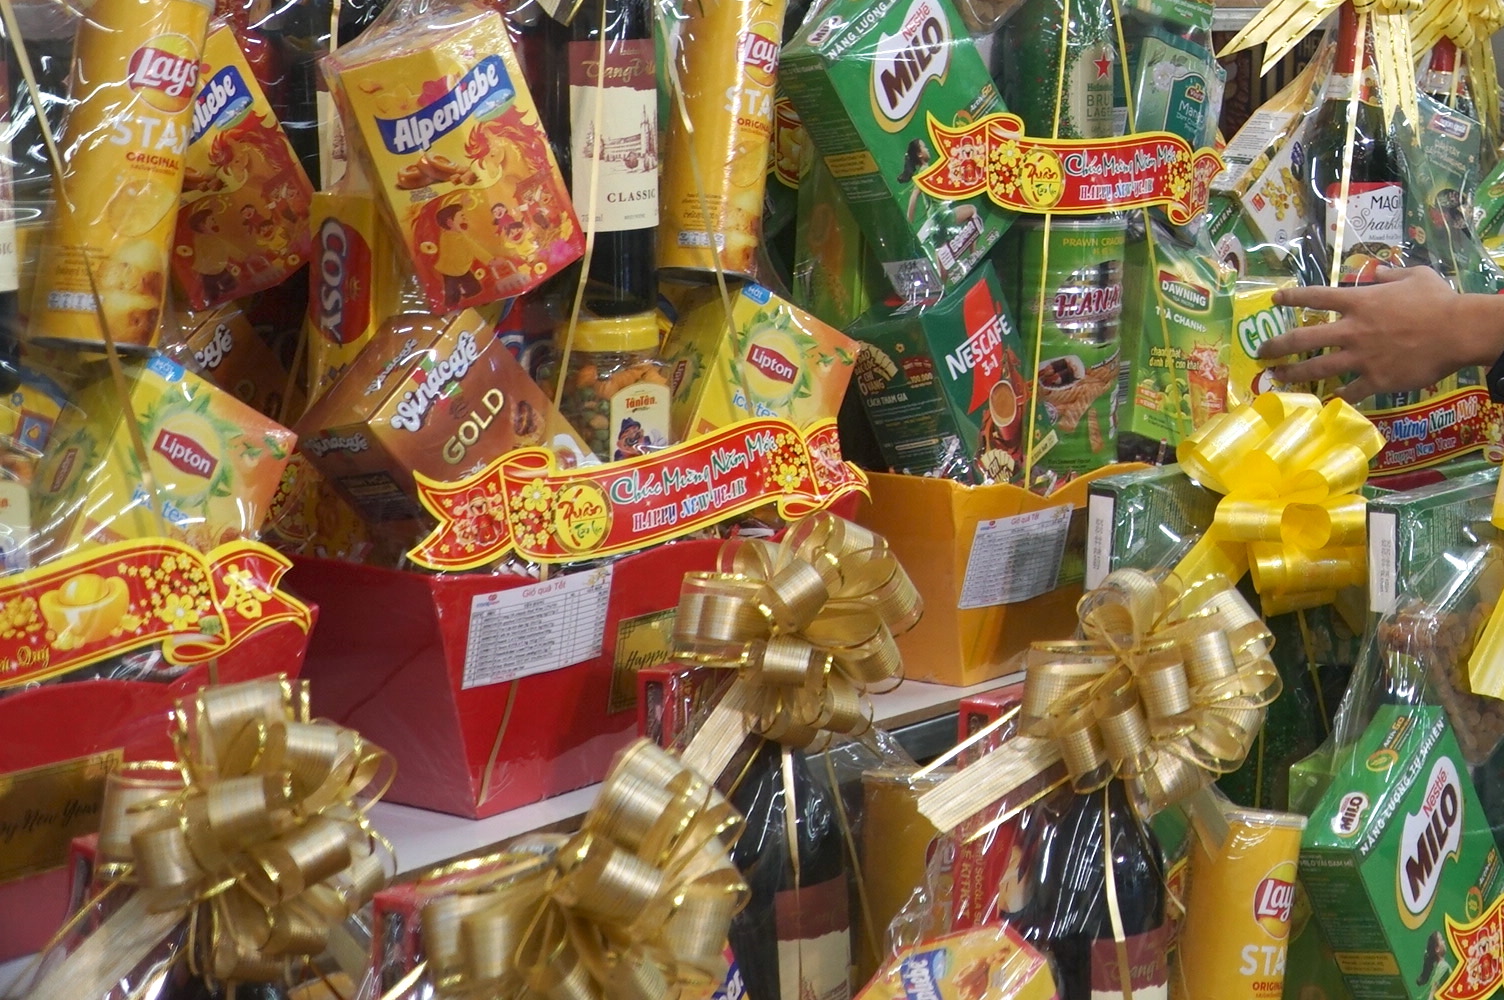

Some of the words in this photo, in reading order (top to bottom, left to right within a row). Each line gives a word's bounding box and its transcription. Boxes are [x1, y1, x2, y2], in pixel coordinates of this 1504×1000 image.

[132, 48, 198, 97] Lay's
[880, 16, 944, 111] MILO
[394, 62, 499, 152] Alpenliebe
[126, 151, 179, 170] ORIGINAL
[1064, 148, 1102, 178] Chúc
[606, 188, 656, 204] CLASSIC
[1079, 183, 1113, 202] HAPPY
[1062, 237, 1098, 248] PRAWN
[320, 217, 347, 349] COSY
[1161, 280, 1207, 307] DAWNING
[390, 330, 480, 433] Vinacafé
[751, 348, 793, 379] Lipton
[442, 388, 505, 465] GOLD
[1392, 416, 1428, 443] Mừng
[1429, 407, 1456, 433] Năm
[159, 433, 213, 475] Lipton
[1416, 442, 1435, 457] New
[609, 468, 662, 505] Chúc
[662, 465, 710, 503] Mừng
[711, 448, 747, 480] Năm
[632, 502, 677, 532] HAPPY
[680, 493, 710, 519] NEW
[713, 478, 748, 508] YEAR
[625, 649, 668, 671] Happy
[1405, 783, 1458, 903] MILO
[960, 862, 971, 920] KITKT
